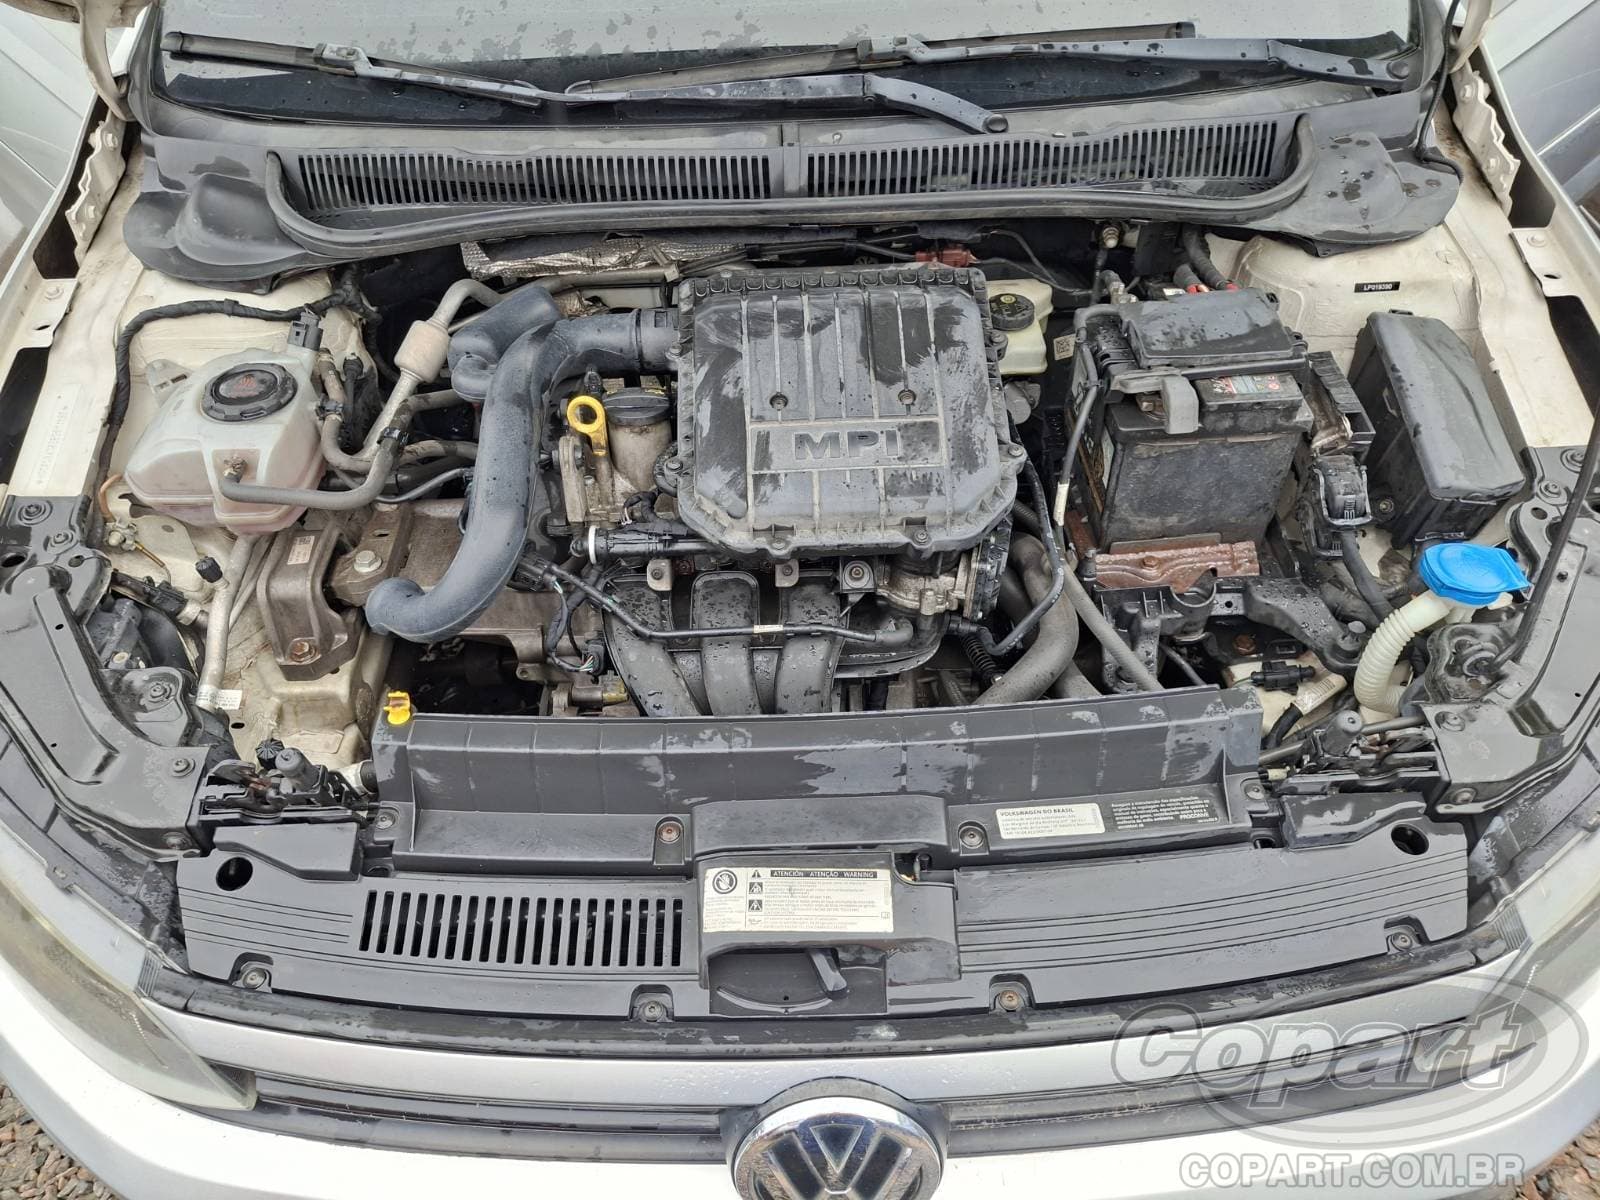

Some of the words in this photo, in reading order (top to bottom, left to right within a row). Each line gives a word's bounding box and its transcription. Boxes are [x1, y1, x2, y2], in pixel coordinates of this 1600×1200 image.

[794, 429, 898, 460] MPI
[1000, 809, 1042, 817] VOLKSWAGEN
[809, 870, 839, 878] ATENÇÃO
